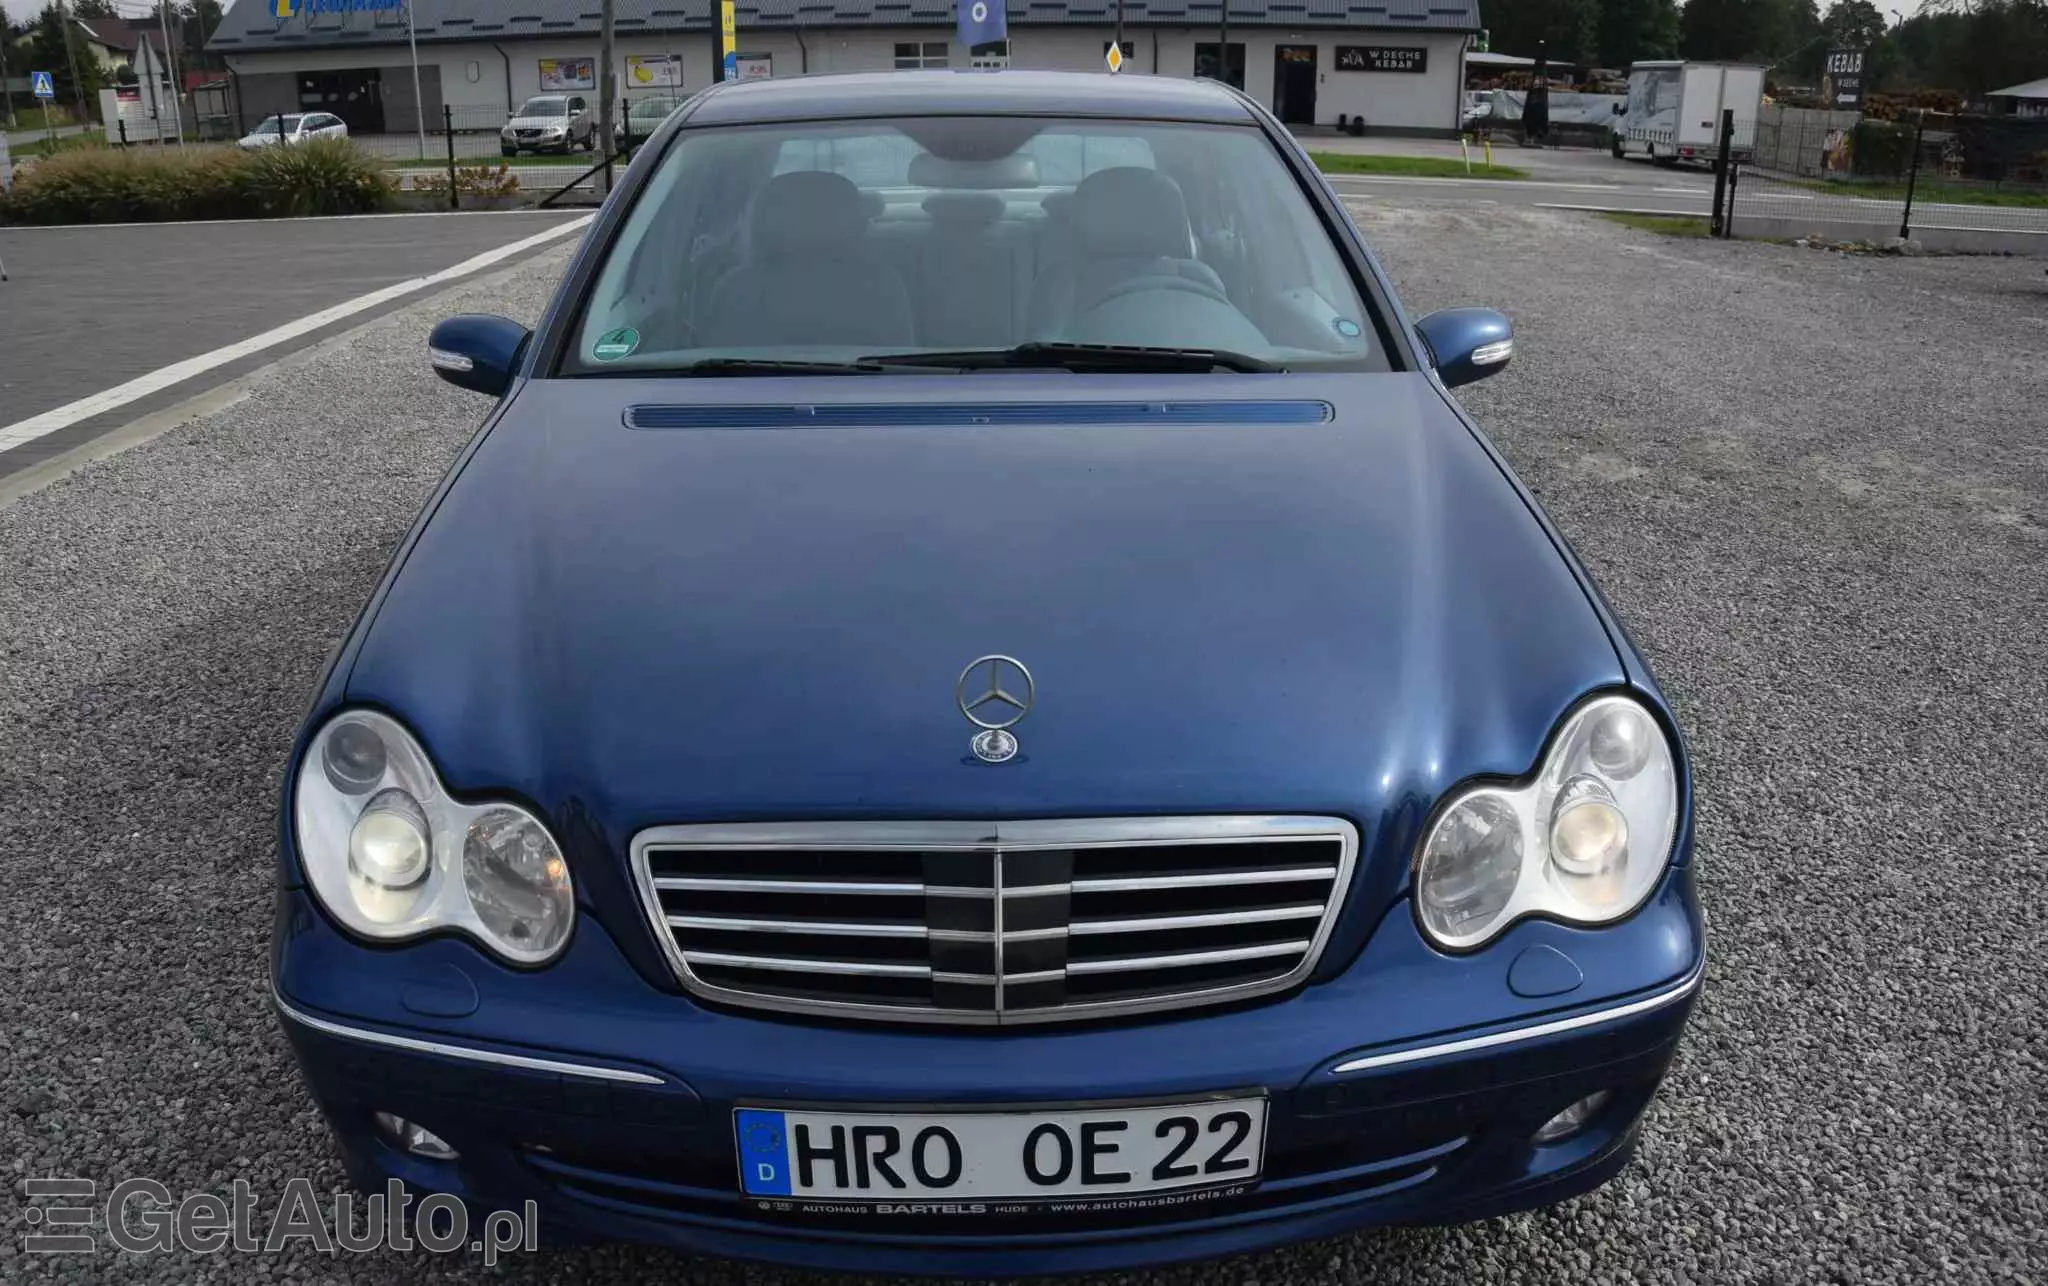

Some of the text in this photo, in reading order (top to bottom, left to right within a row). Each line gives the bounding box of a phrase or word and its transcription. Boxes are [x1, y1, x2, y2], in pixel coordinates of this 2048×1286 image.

[1369, 50, 1379, 58] W
[1827, 53, 1862, 72] KEBAB
[1375, 59, 1412, 68] KEBAB
[611, 329, 627, 344] 4
[795, 1110, 1252, 1189] HRO OE 22
[758, 1163, 776, 1181] D
[802, 1204, 869, 1214] AUTOHAUS
[876, 1204, 987, 1214] BARTELS
[995, 1205, 1029, 1213] HUDE
[1050, 1186, 1245, 1212] www.autohausbartels.de
